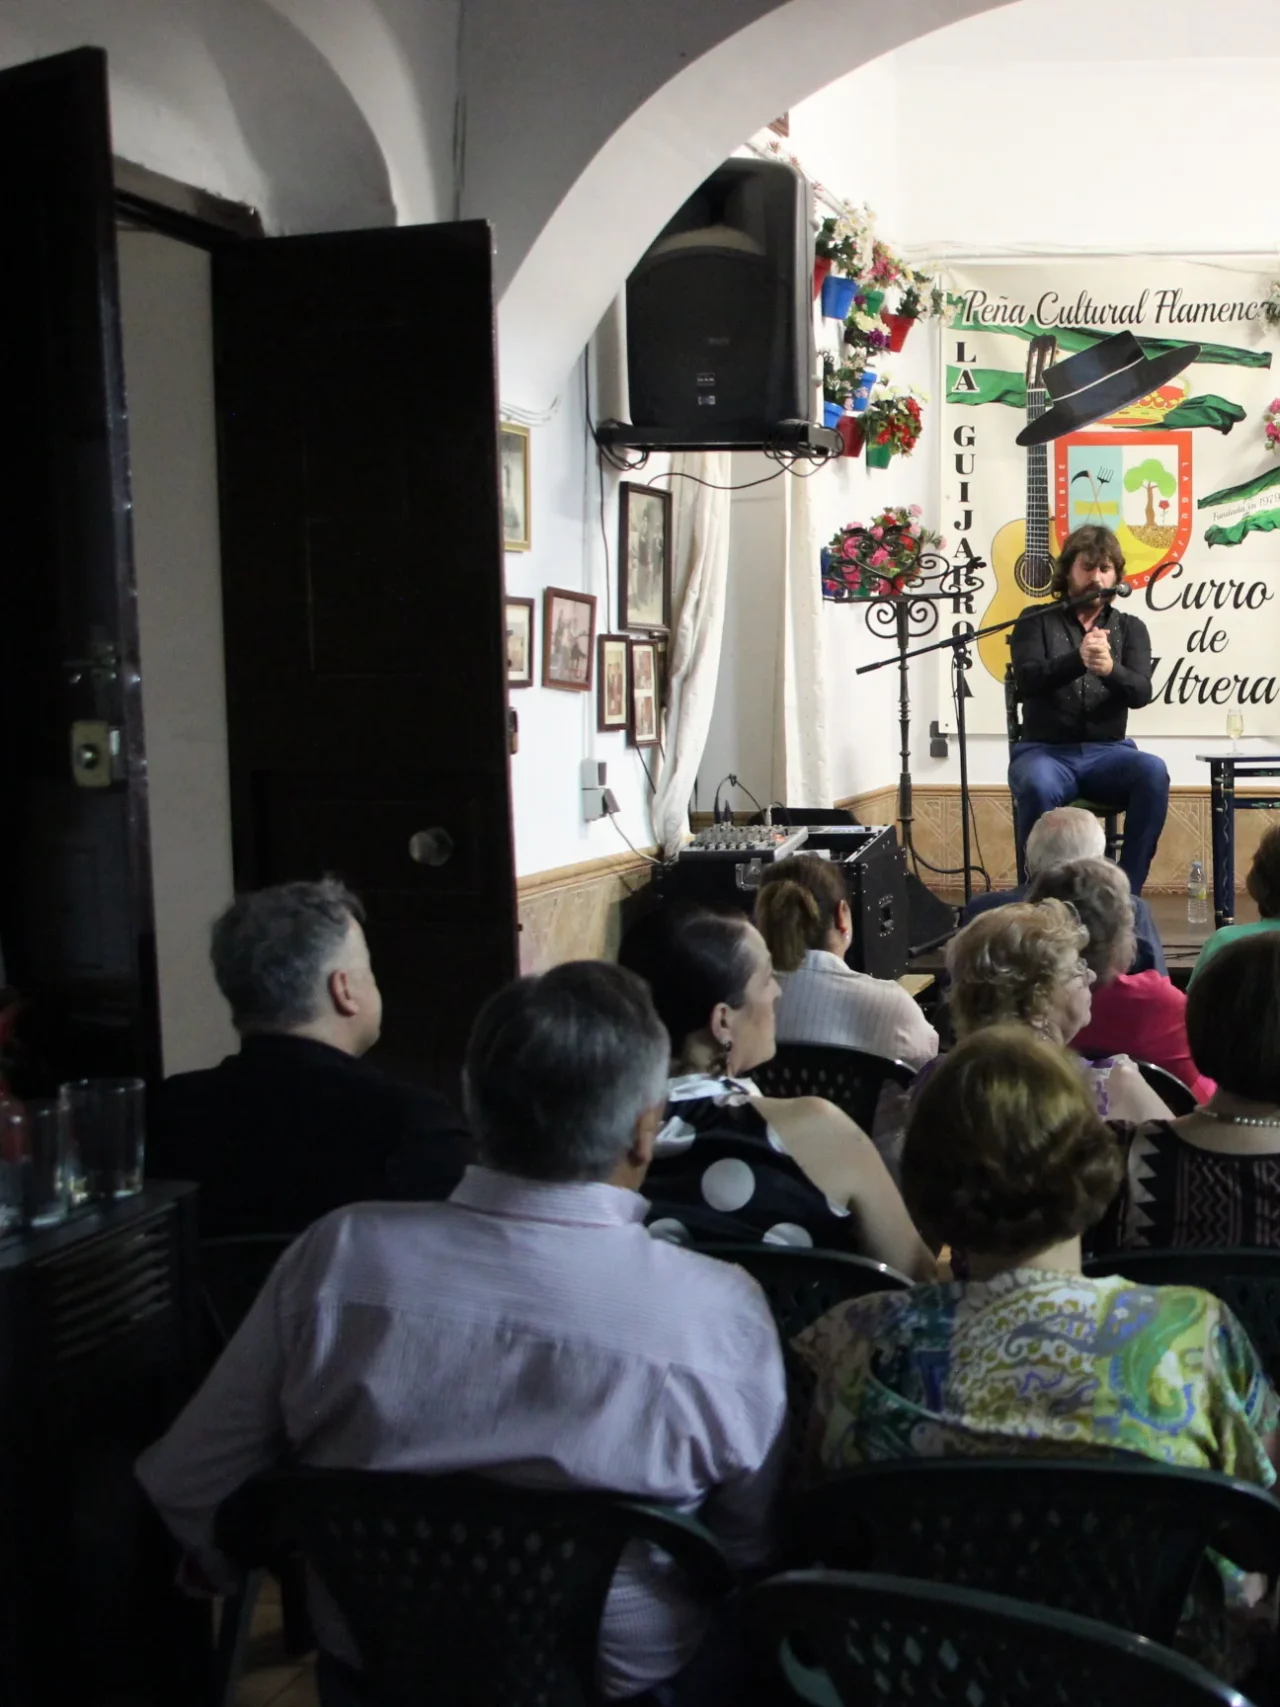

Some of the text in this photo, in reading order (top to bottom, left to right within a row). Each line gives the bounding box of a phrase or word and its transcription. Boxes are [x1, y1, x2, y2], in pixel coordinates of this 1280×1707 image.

[964, 287, 1274, 326] Peña Cultural Flamenc
[955, 341, 977, 391] LA
[1058, 463, 1067, 519] LIBRE
[1260, 492, 1280, 507] 1979
[1132, 461, 1189, 586] LA GUIJAOS
[1145, 561, 1275, 611] Curro
[1187, 616, 1229, 653] de
[1149, 657, 1280, 705] Utrera
